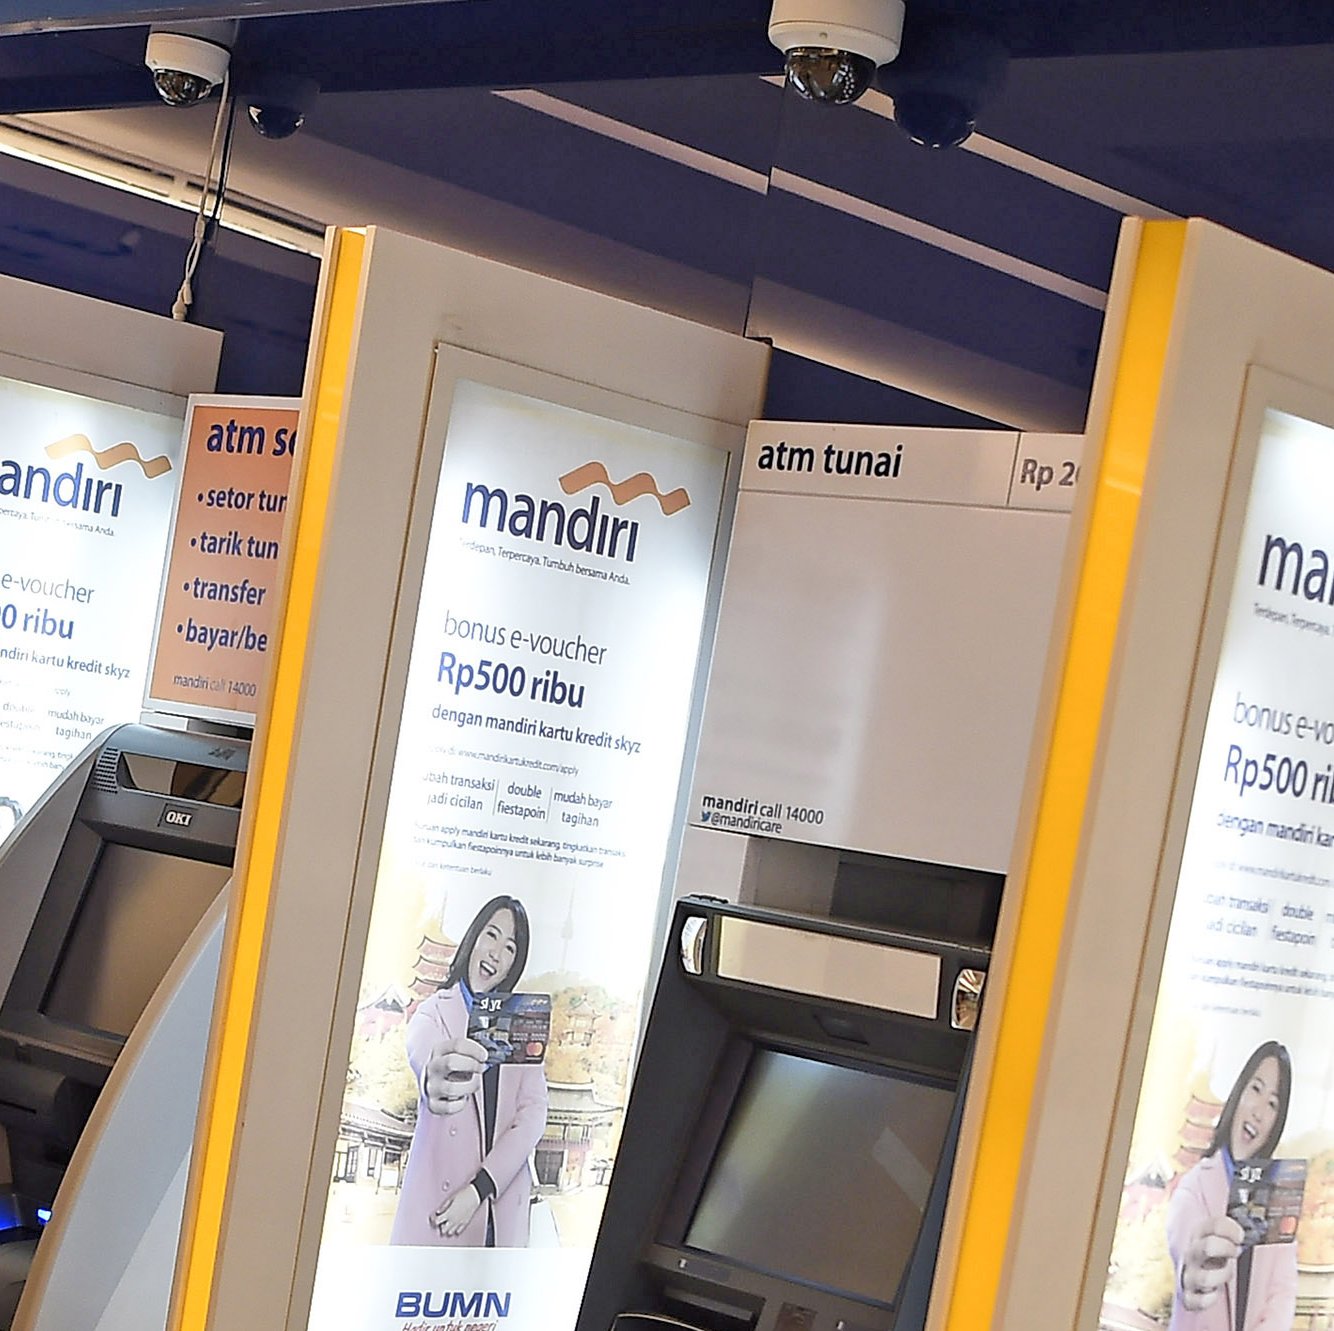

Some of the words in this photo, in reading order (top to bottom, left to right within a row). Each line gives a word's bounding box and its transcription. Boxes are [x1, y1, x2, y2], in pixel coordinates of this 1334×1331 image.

[208, 419, 264, 455] atm
[757, 439, 815, 473] atm
[823, 443, 903, 478] tunai
[1020, 458, 1053, 491] Rp
[207, 486, 254, 509] setor
[462, 481, 639, 562] mandiri
[200, 531, 241, 557] tarik
[247, 538, 278, 560] tun
[543, 556, 575, 572] Tumbuh
[576, 564, 607, 580] bersama
[1, 573, 95, 605] e-voucher
[194, 576, 266, 606] transfer
[23, 607, 74, 641] ribu
[444, 610, 505, 645] bonus
[510, 629, 607, 665] e-voucher
[31, 650, 64, 670] kartu
[66, 656, 103, 675] kredit
[104, 664, 130, 681] skyz
[437, 652, 525, 696] Rp500
[531, 670, 585, 708] ribu
[173, 673, 208, 691] mandiri
[228, 681, 257, 697] 14000
[48, 709, 78, 722] mudah
[1234, 692, 1292, 735] bonus
[55, 726, 92, 741] tagihan
[432, 704, 482, 728] dengan
[485, 711, 536, 735] mandiri
[539, 717, 573, 742] kartu
[575, 724, 612, 750] kredit
[614, 732, 641, 755] skyz
[451, 774, 495, 791] transaksi
[1223, 744, 1307, 797] Rp500
[450, 794, 483, 811] cicilan
[507, 782, 542, 799] double
[554, 790, 586, 806] mudah
[587, 795, 613, 811] bayar
[166, 810, 191, 827] OKI
[497, 801, 545, 820] fiestapoin
[561, 811, 599, 827] tagihan
[702, 794, 758, 816] mandiri
[760, 802, 782, 821] call
[786, 805, 824, 826] 14000
[711, 812, 782, 834] @mandiricare
[395, 1292, 511, 1318] BUMN
